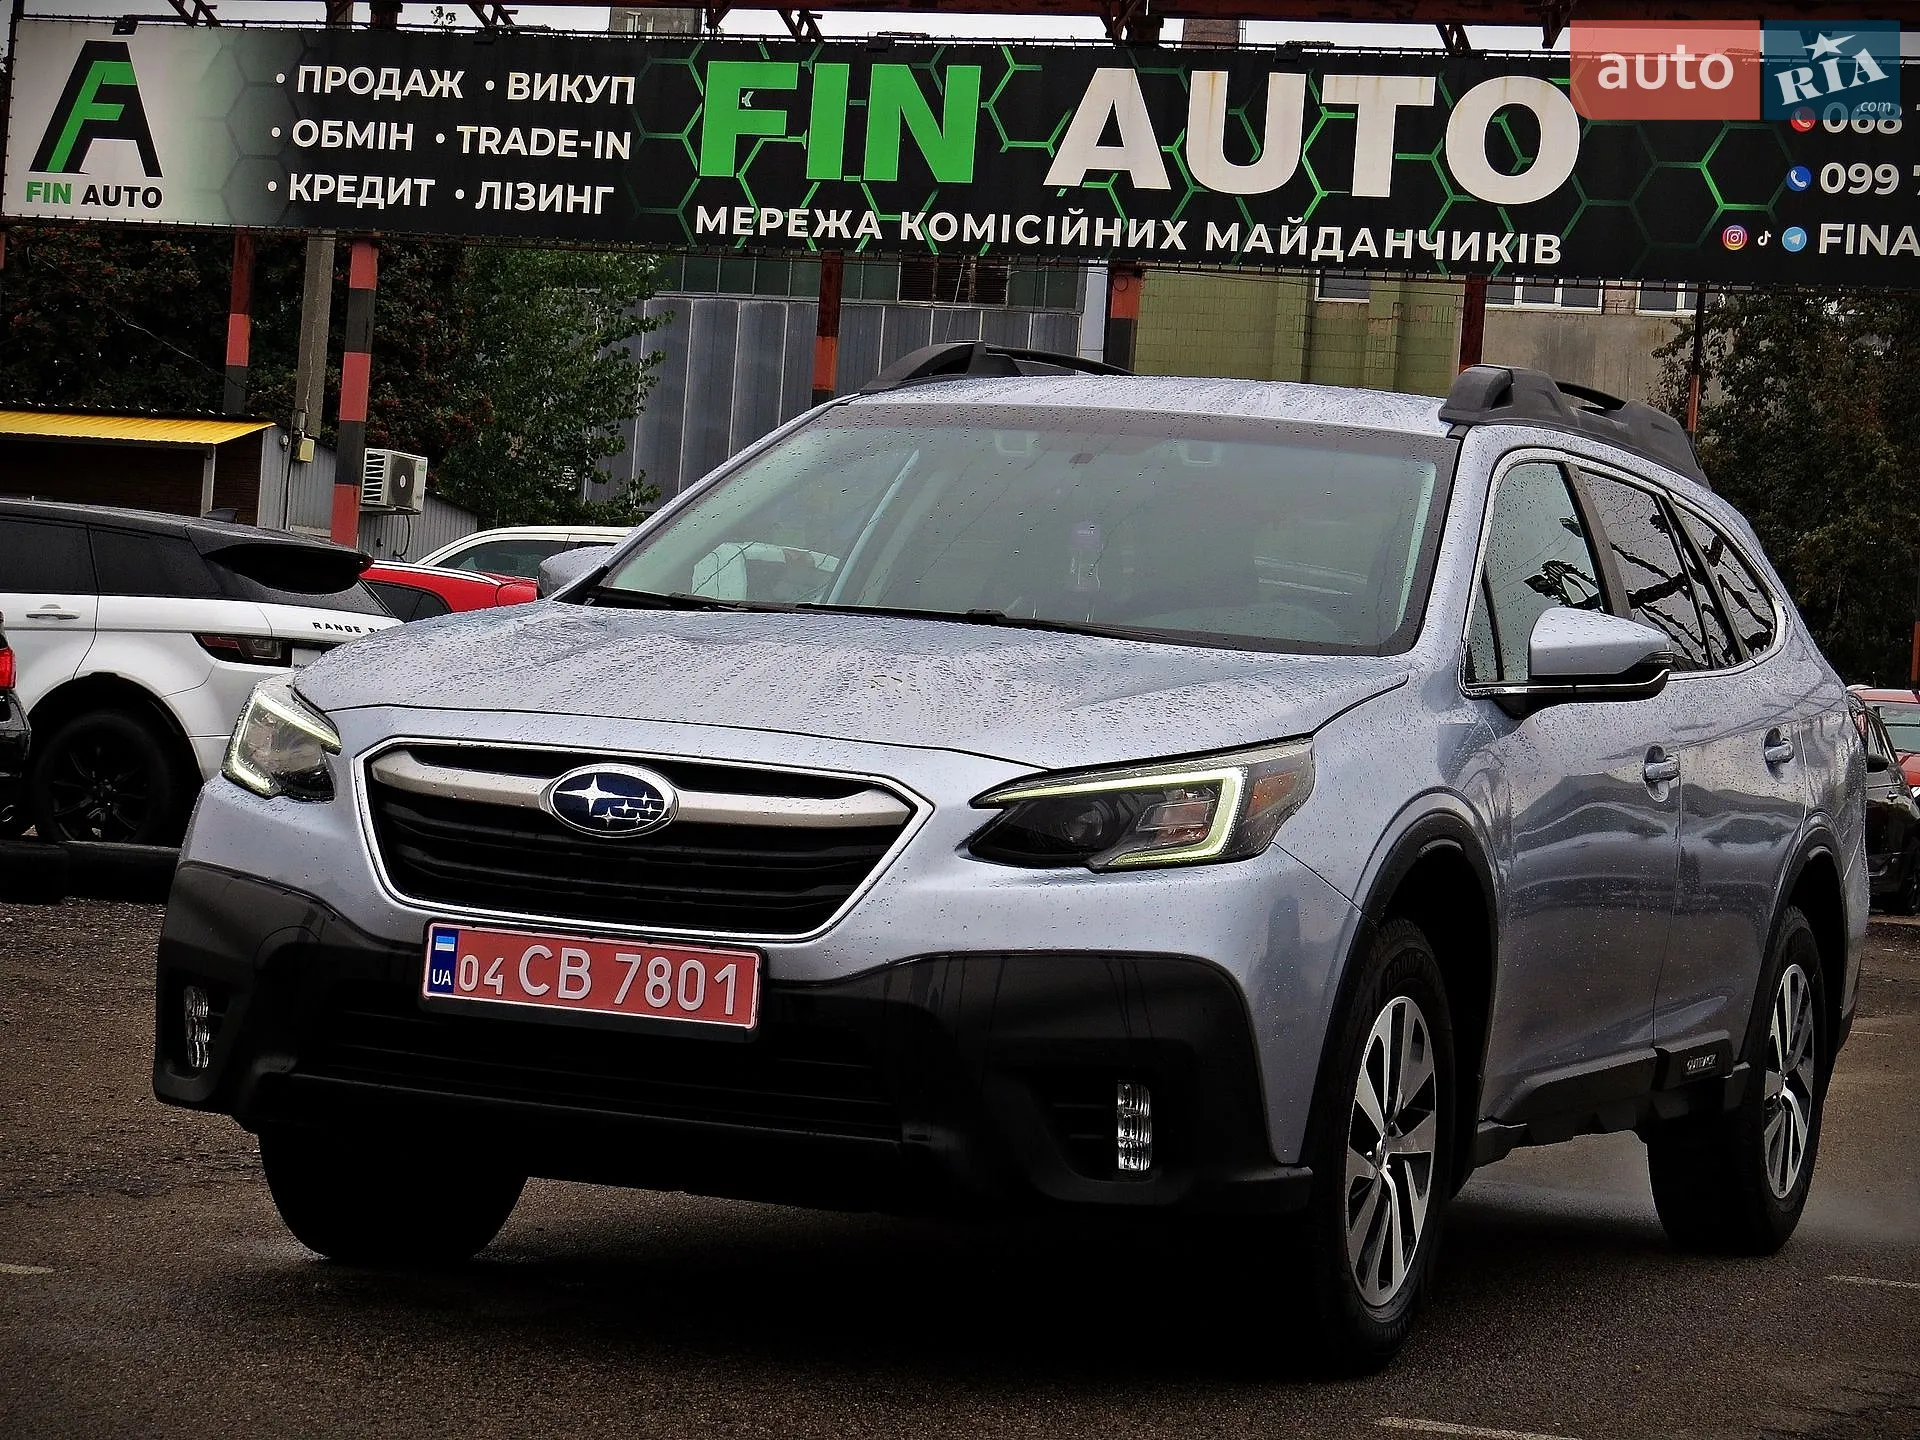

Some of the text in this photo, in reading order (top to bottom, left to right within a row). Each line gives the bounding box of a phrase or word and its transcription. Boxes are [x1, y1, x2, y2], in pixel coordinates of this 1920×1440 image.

[297, 65, 465, 101] ПРОДАЖ
[507, 72, 635, 104] ВИКУП
[699, 60, 1581, 205] FIN AUTO
[1822, 101, 1903, 134] 068
[292, 119, 414, 151] ОБМІН
[456, 125, 632, 160] TRADE-IN
[25, 181, 163, 208] FIN AUTO
[289, 173, 435, 210] КРЕДИТ
[1820, 162, 1900, 195] 099
[475, 181, 615, 214] ЛІЗИНГ
[695, 205, 1562, 264] МЕРЕЖА КОМІСІЙНИХ МАЙДАНЧИКІВ
[312, 622, 362, 634] RANGE
[432, 968, 452, 986] UA
[458, 945, 737, 1015] 04 CB 7801
